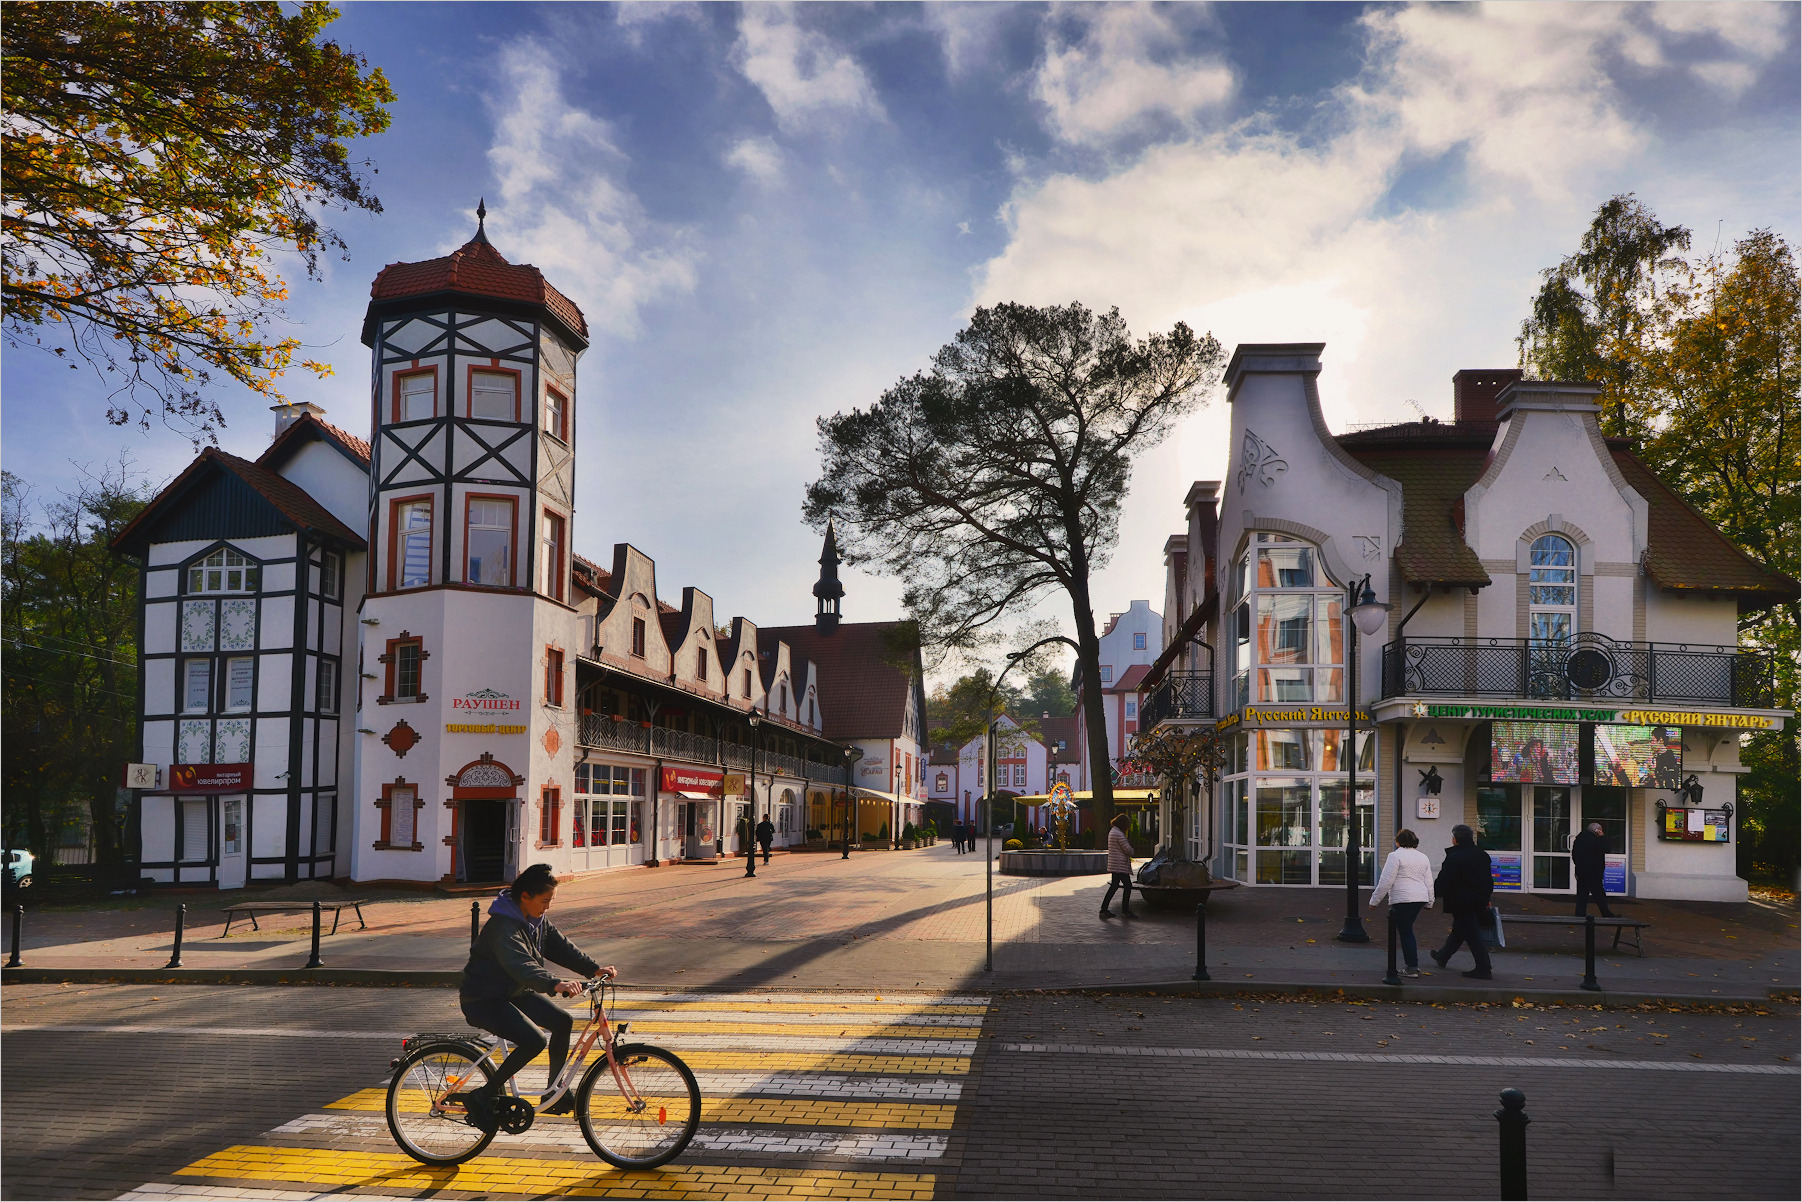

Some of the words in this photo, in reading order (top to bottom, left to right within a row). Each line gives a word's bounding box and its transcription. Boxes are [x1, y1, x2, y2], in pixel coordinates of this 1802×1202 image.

[452, 698, 521, 710] РАУШЕН
[1243, 706, 1307, 725] Русский
[1427, 705, 1470, 718] ЦЕНТР
[1470, 705, 1578, 720] ТУРИСТИЧЕСКИХ
[1577, 709, 1620, 722] УСЛУГ
[445, 723, 496, 733] ТОРГОВЫЙ
[497, 725, 528, 735] ЦЕНТР
[197, 778, 241, 786] ювелирпром
